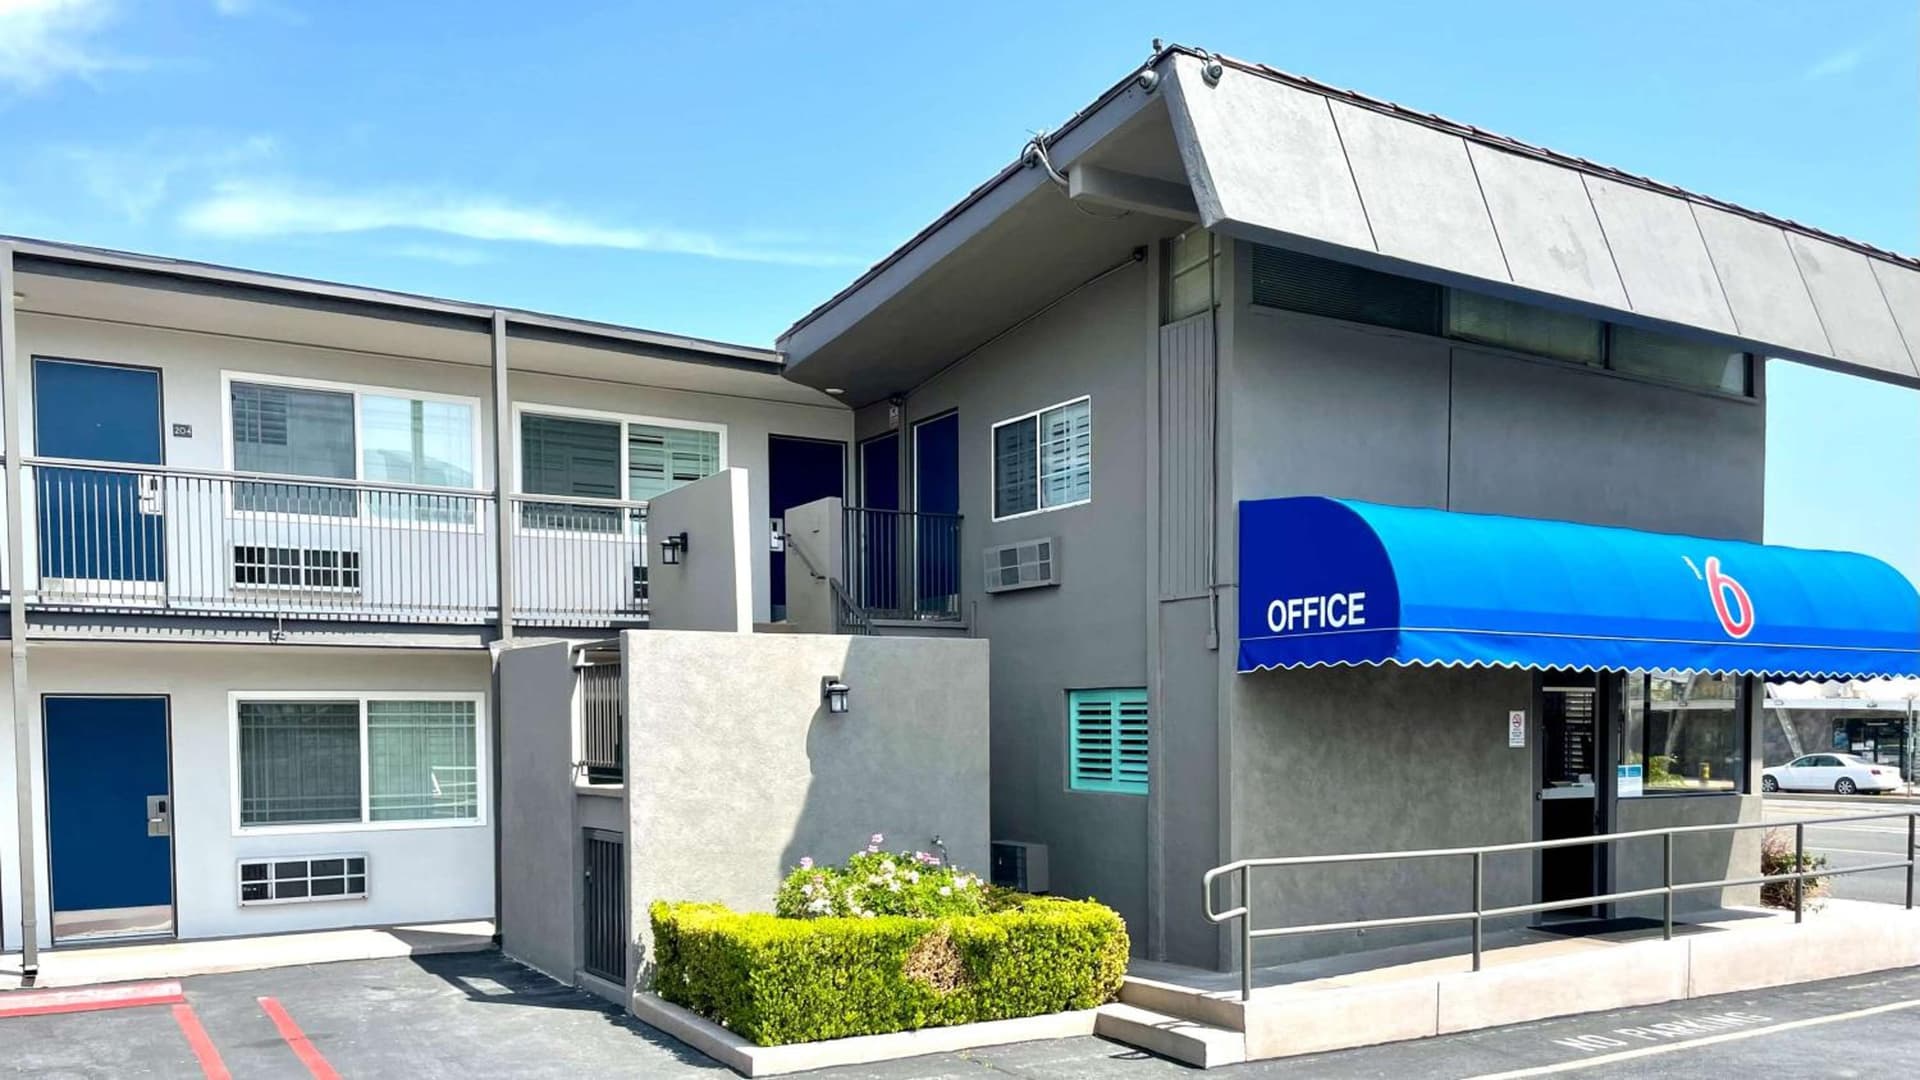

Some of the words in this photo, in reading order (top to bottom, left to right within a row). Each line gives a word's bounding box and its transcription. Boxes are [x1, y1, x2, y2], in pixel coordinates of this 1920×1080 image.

[174, 426, 191, 435] 204
[1267, 592, 1365, 632] OFFICE
[1552, 1034, 1628, 1051] NO
[1613, 1011, 1772, 1041] PARKING
